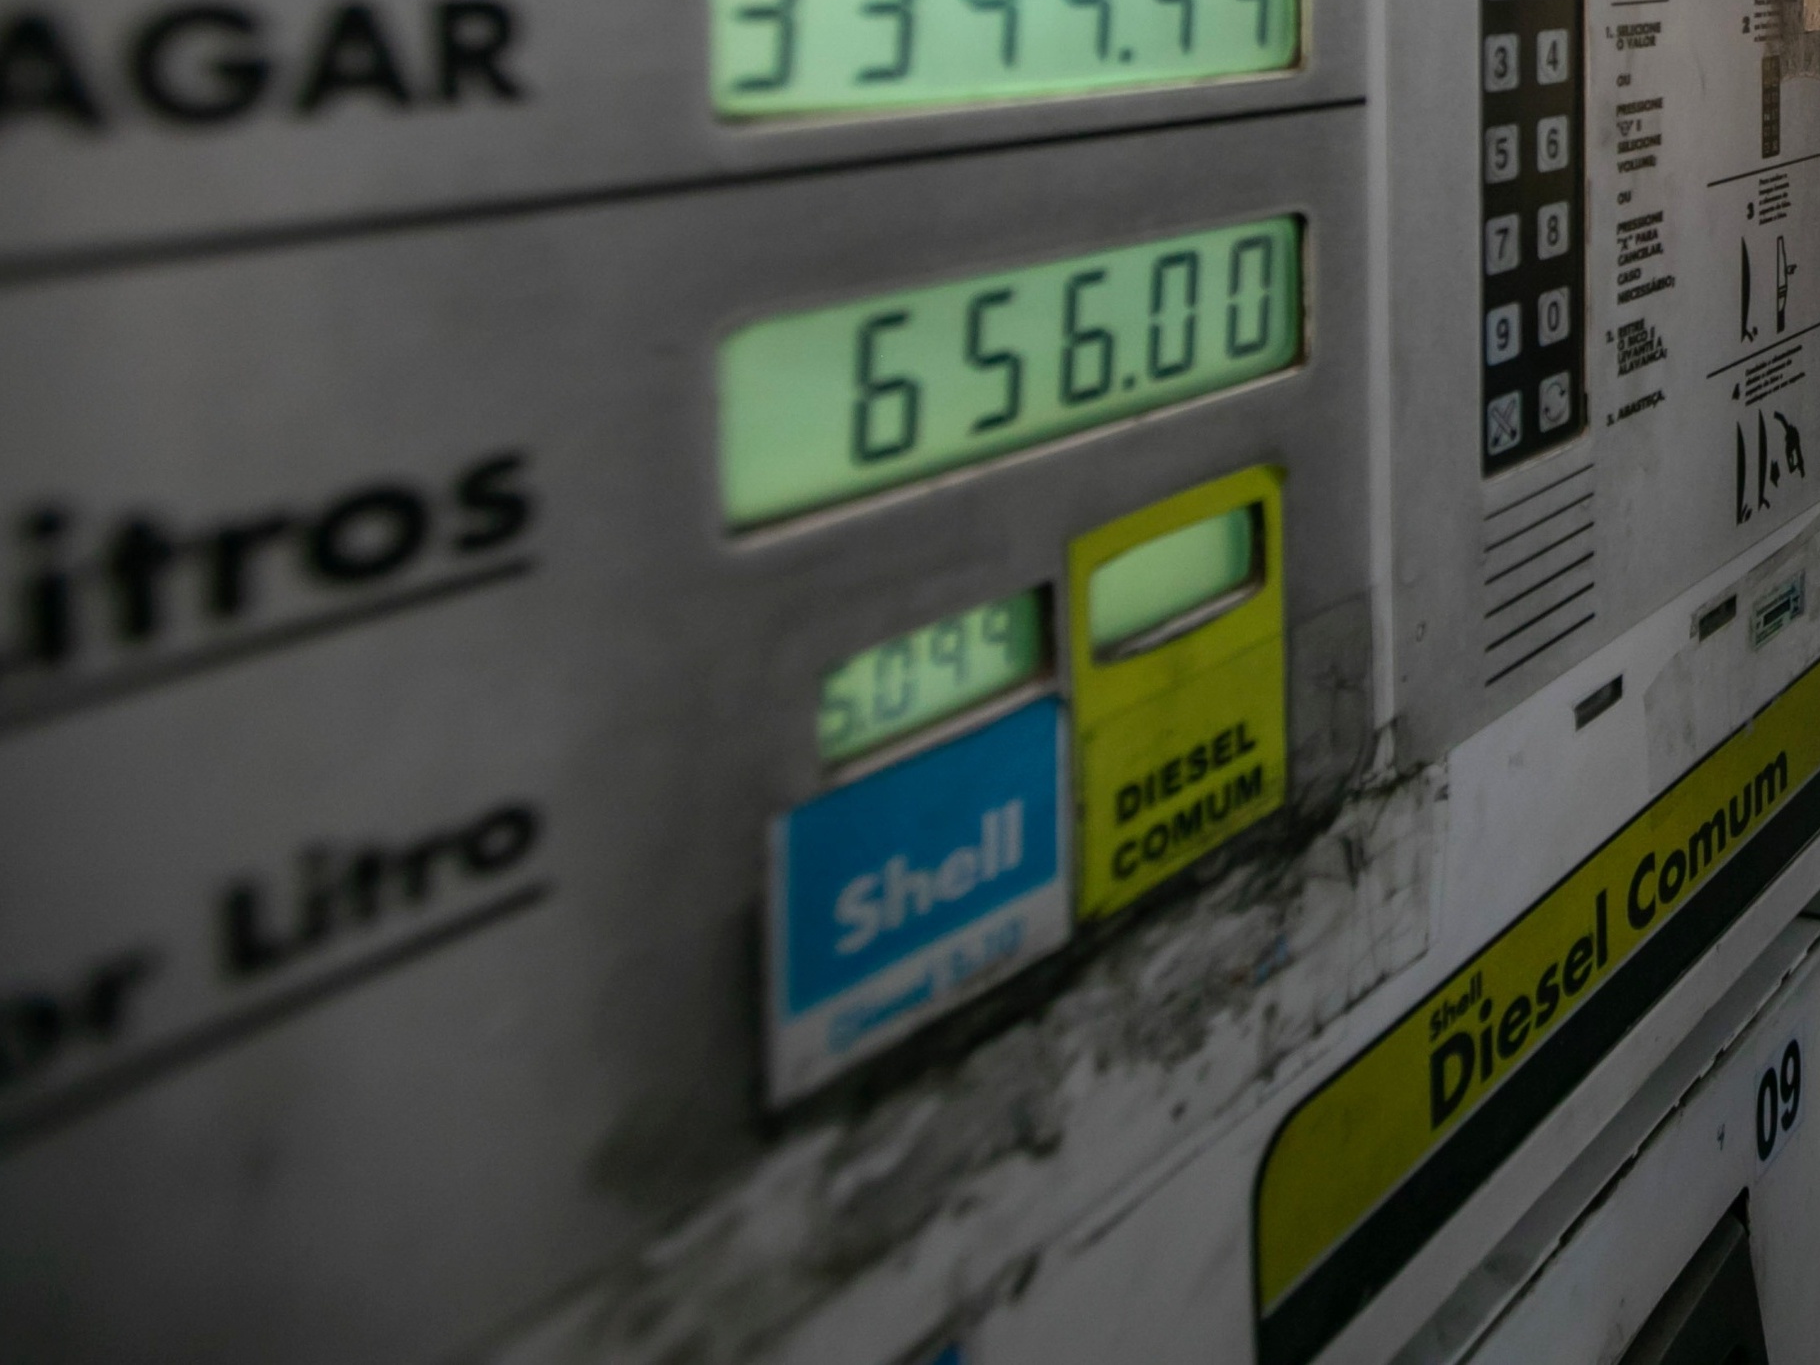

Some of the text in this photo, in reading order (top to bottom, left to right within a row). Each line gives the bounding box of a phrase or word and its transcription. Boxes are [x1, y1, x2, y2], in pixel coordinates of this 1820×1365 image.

[1493, 38, 1561, 82] 3 4
[1493, 125, 1561, 172] 5 6
[1493, 213, 1560, 263] 7 8
[851, 236, 1274, 465] 656.00
[1494, 300, 1562, 353] 9 0
[0, 447, 538, 665] itros
[1112, 765, 1264, 881] COMUM
[1115, 721, 1258, 824] DIESEL
[216, 800, 542, 981] Litro
[834, 797, 1025, 954] Shell
[1429, 750, 1788, 1131] Diesel Comum
[1429, 970, 1483, 1041] Shell
[1757, 1039, 1800, 1162] 09
